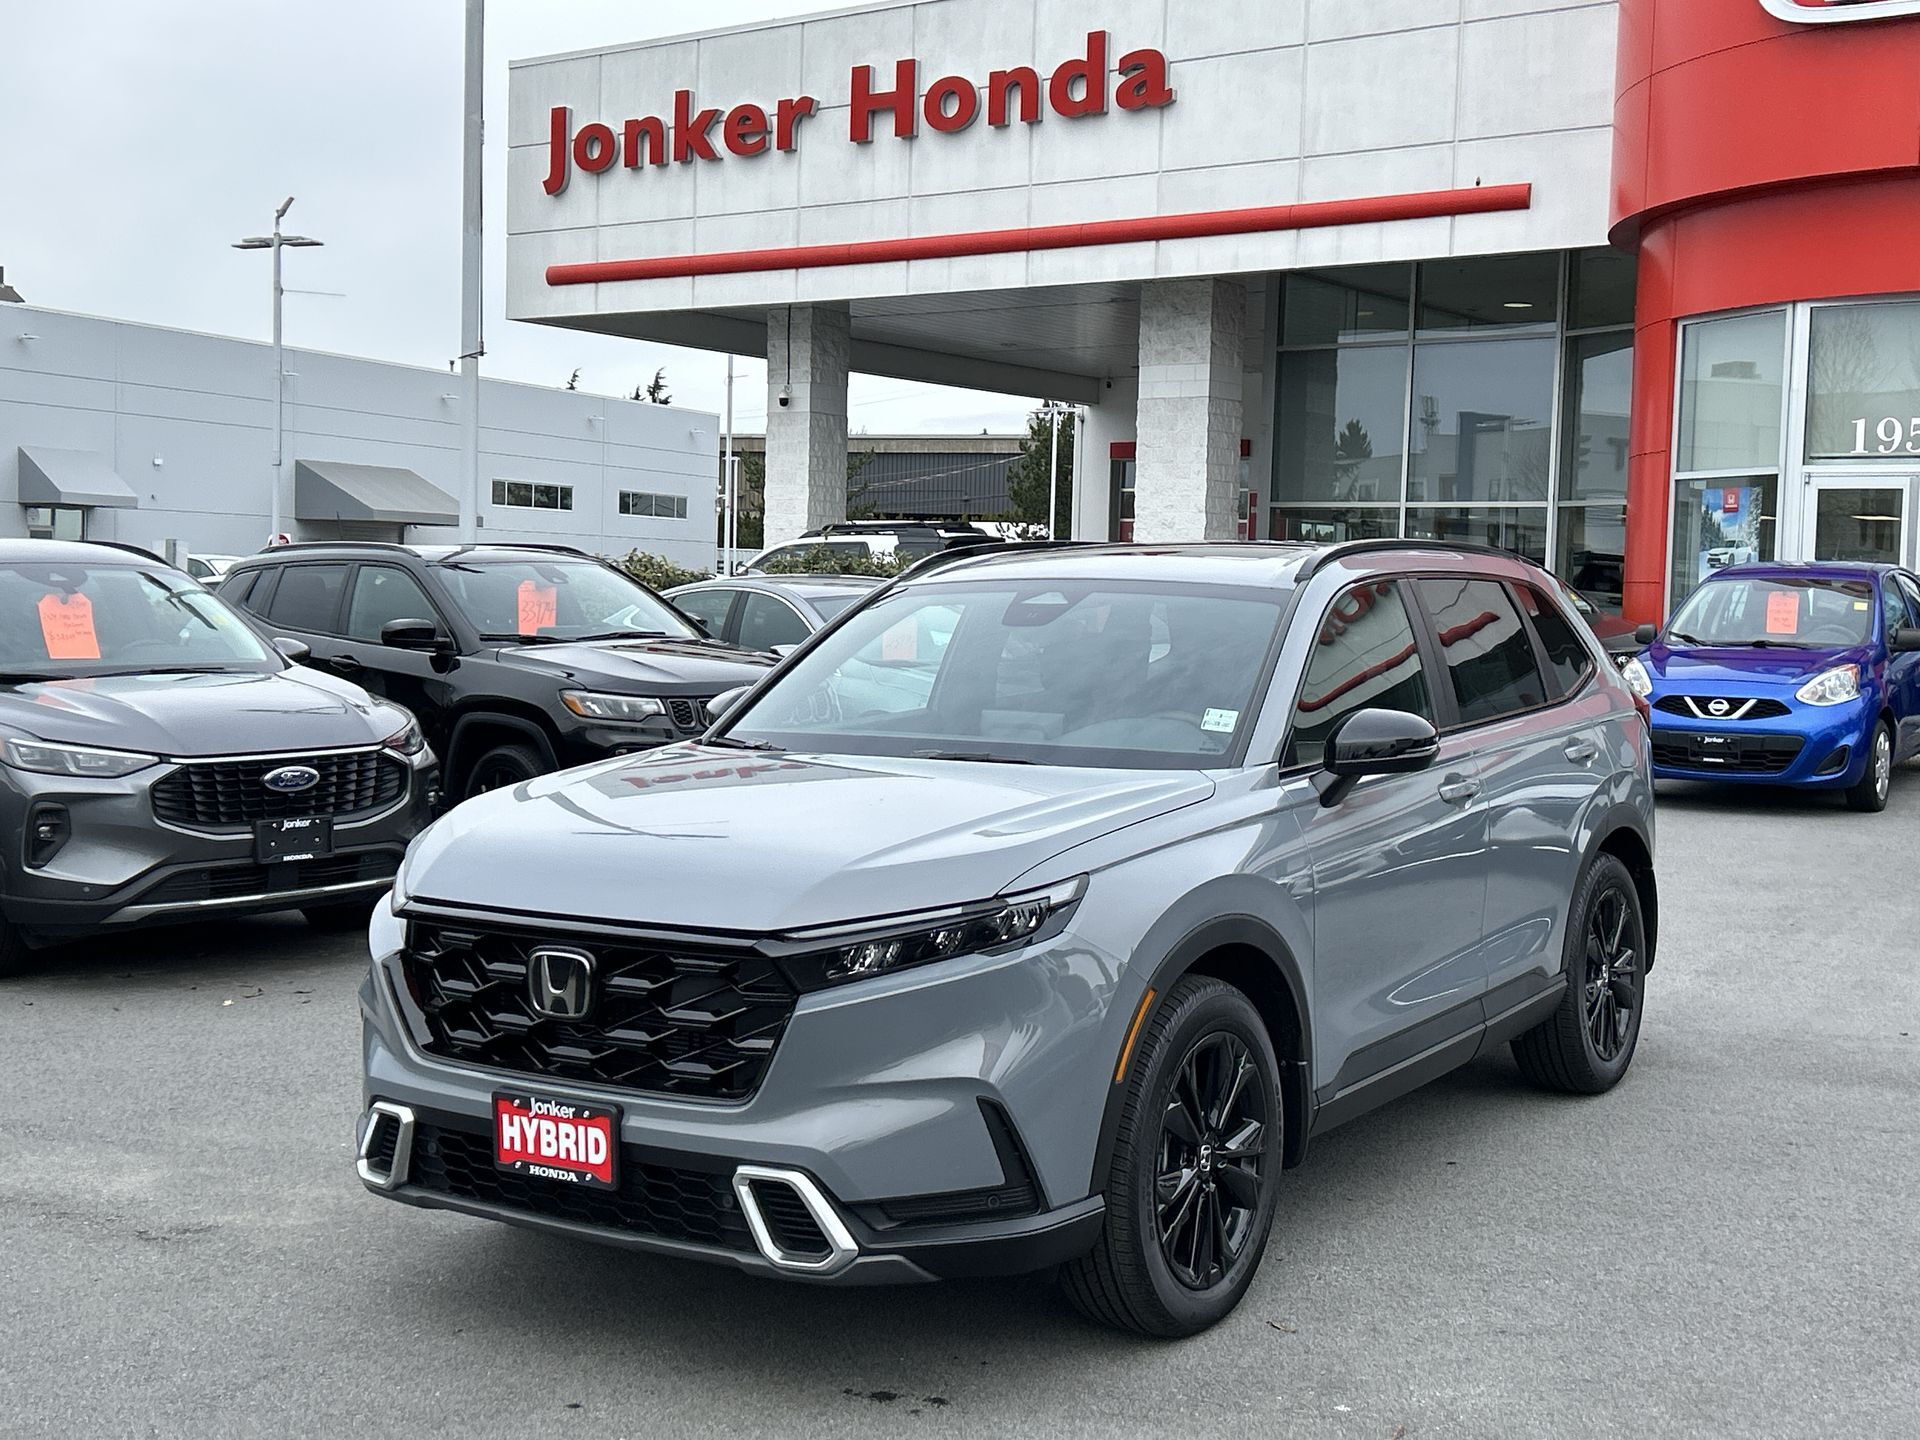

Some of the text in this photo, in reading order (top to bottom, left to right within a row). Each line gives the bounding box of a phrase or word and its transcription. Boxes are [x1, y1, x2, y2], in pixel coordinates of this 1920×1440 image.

[543, 29, 1178, 197] Jonker Honda
[528, 1097, 576, 1119] Jonker
[501, 1112, 607, 1165] HYBRID
[528, 1164, 579, 1183] HONDA
